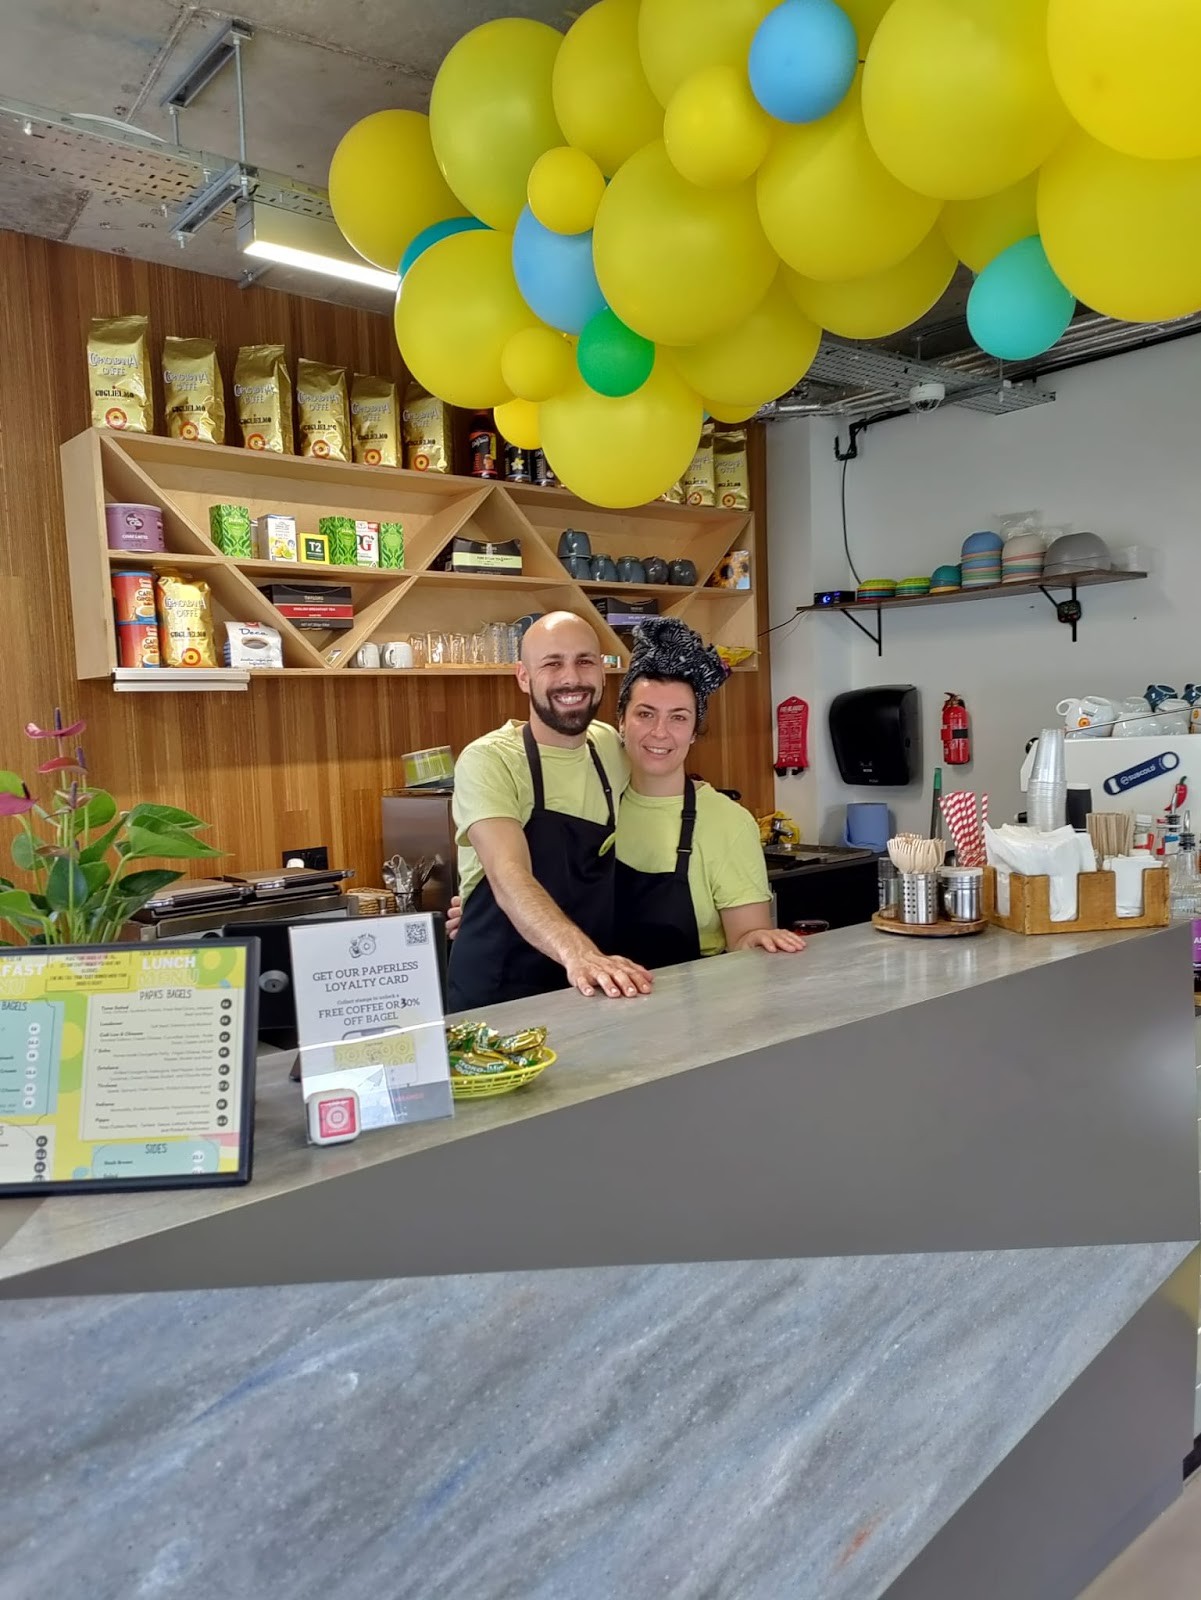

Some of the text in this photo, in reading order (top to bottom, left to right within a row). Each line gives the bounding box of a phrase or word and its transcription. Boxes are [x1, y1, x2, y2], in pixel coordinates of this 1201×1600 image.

[308, 541, 322, 552] T2
[142, 955, 196, 970] LUNCH
[312, 960, 419, 982] GET OUR PAPERLESS
[325, 974, 409, 993] LOYALTY CARD
[1, 1001, 27, 1011] BAGELS
[318, 1008, 345, 1019] FREE
[345, 1002, 385, 1015] COFFEE
[385, 1000, 401, 1009] OR
[343, 1011, 399, 1026] OFF BAGEL
[145, 1143, 167, 1154] SIDES
